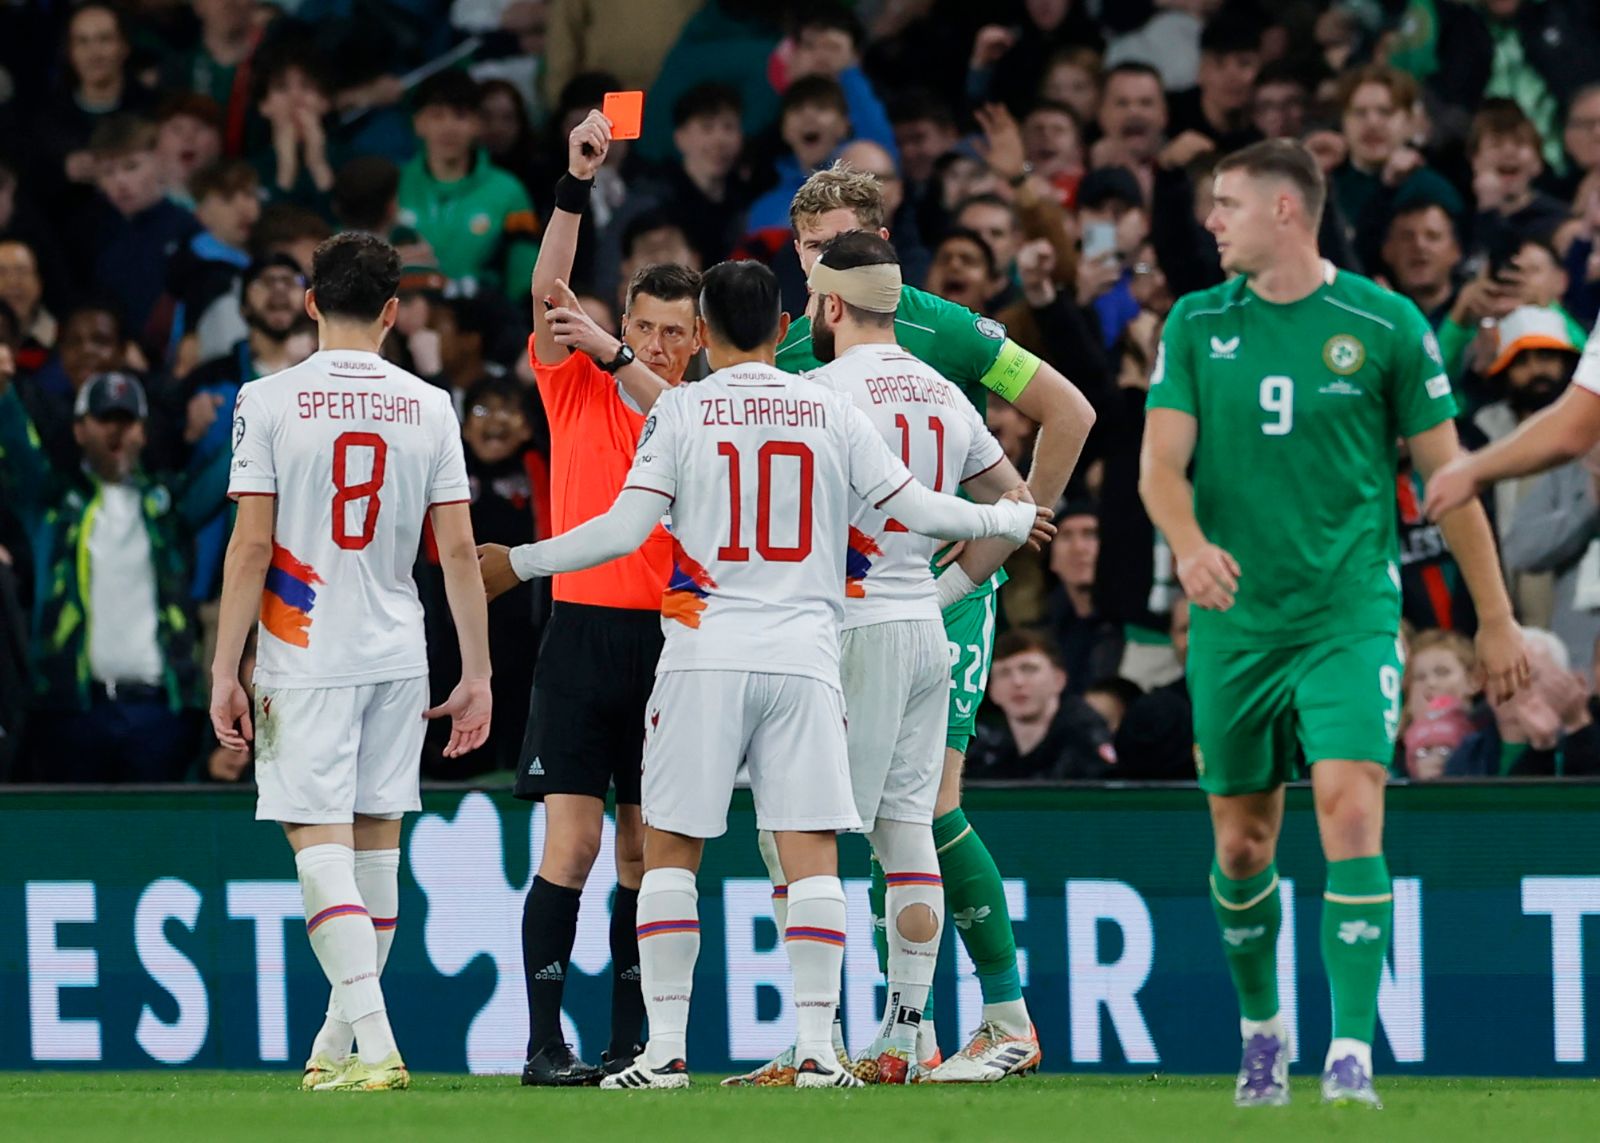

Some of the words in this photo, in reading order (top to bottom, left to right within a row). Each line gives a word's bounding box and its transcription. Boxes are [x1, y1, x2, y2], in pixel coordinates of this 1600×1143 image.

[298, 391, 420, 426] SPERTSYAN
[700, 398, 826, 429] ZELARAYAN
[1259, 376, 1294, 435] 9
[332, 431, 387, 550] 8
[718, 440, 814, 562] 10
[1379, 664, 1400, 722] 9
[25, 876, 306, 1064] EST
